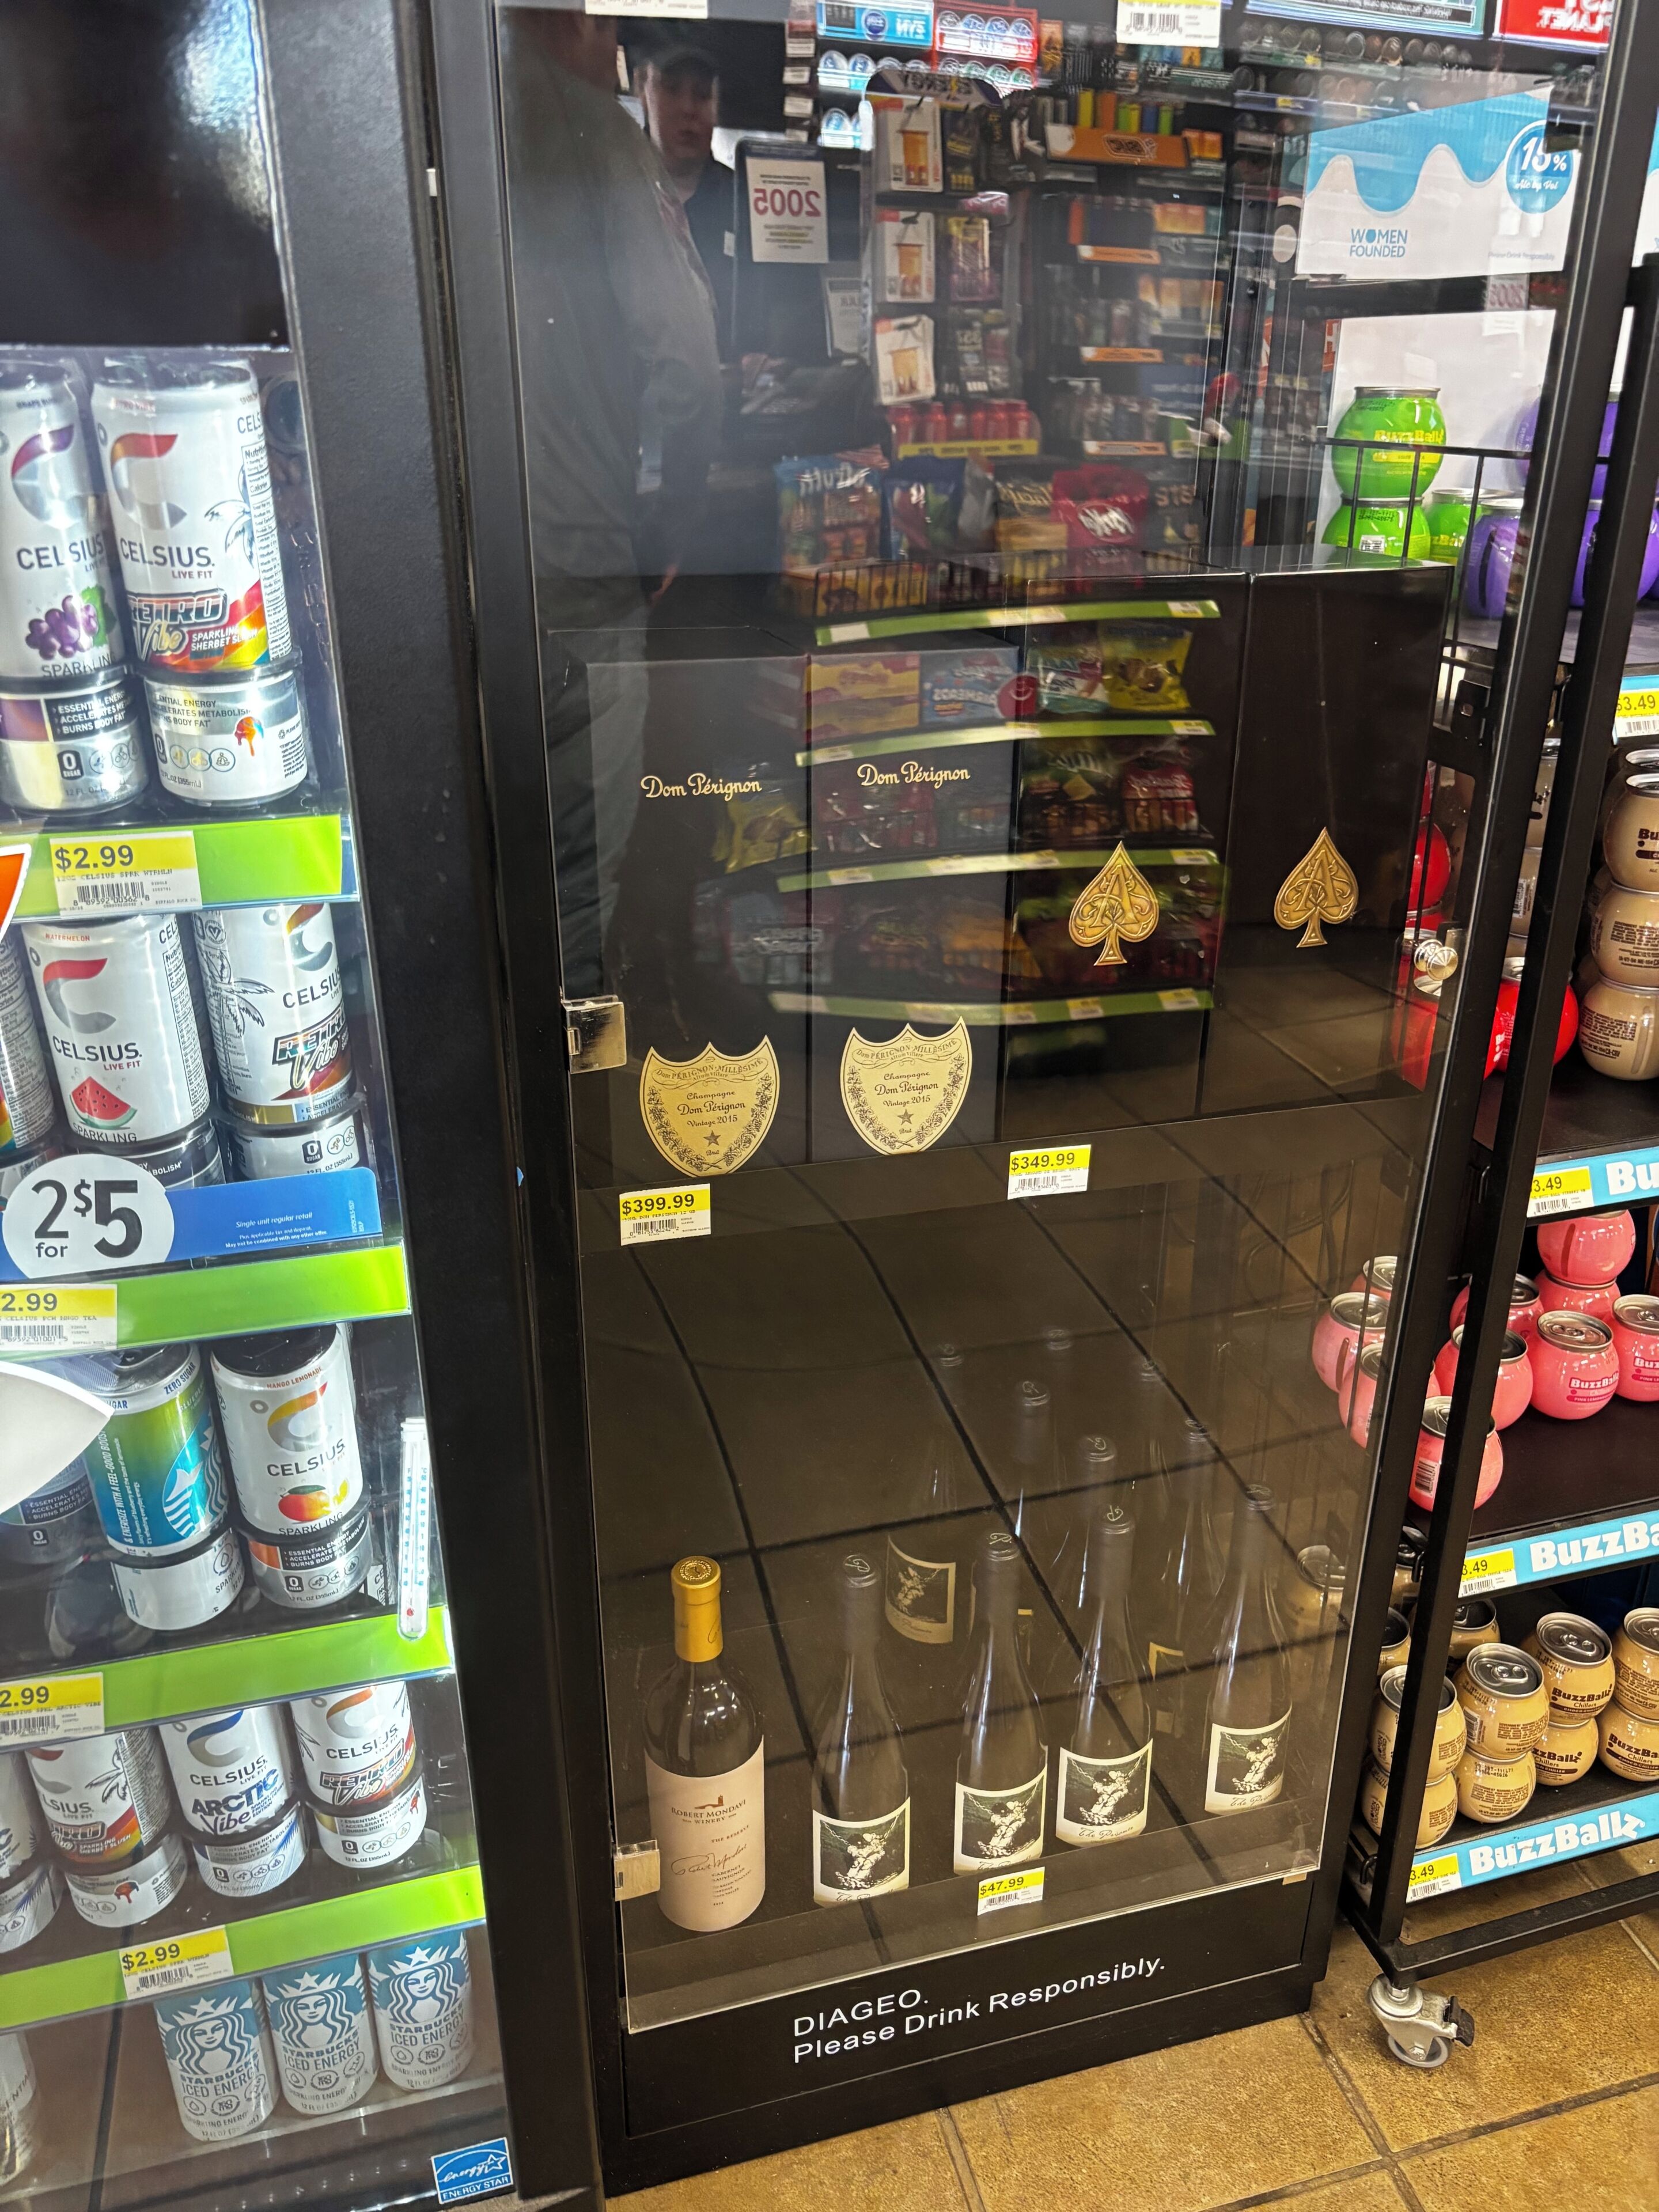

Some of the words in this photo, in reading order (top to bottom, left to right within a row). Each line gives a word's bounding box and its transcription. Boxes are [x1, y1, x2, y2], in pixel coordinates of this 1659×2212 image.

[1349, 245, 1406, 258] FOUNDED
[17, 533, 105, 571] CELSIUS
[119, 536, 215, 568] CELSIUS.
[172, 570, 194, 579] LIVE
[196, 570, 213, 579] FIT
[191, 636, 231, 652] SHERBET
[183, 699, 217, 709] ENERGY
[1616, 694, 1656, 713] $3.49
[62, 722, 94, 734] BURNS
[94, 715, 114, 730] BODY
[173, 716, 193, 726] BODY
[62, 752, 77, 771] 0
[857, 764, 900, 786] Dom
[900, 760, 971, 790] Pérignon
[640, 775, 687, 798] Dom
[687, 772, 763, 802] Pérignon
[54, 844, 134, 873] $2.99
[81, 872, 115, 881] CELSIUS
[45, 932, 90, 942] WATERMELON
[282, 968, 341, 1009] CELSIUS
[52, 1035, 143, 1062] CELSIUS.
[856, 1049, 870, 1059] Dom
[103, 1063, 125, 1071] LIVE
[127, 1060, 141, 1070] FIT
[657, 1069, 671, 1079] Dom
[884, 1071, 930, 1081] Champagne
[686, 1090, 736, 1101] Champagne
[874, 1084, 899, 1096] Dom
[899, 1081, 939, 1094] Pérignon
[677, 1103, 703, 1116] Dom
[703, 1100, 746, 1115] Pérignon
[882, 1100, 910, 1108] Vintage
[911, 1095, 931, 1104] 2015
[687, 1119, 716, 1128] Vintage
[716, 1114, 738, 1124] 2015
[73, 1123, 137, 1143] SPARKLING
[306, 1153, 321, 1161] SUGAR
[308, 1141, 316, 1155] 0
[706, 1149, 719, 1157] Brut
[334, 1152, 353, 1169] (355mL)
[1011, 1152, 1075, 1173] $349.99
[1533, 1175, 1562, 1193] 3.49
[31, 1179, 69, 1239] 2
[622, 1194, 695, 1217] $399.99
[236, 1218, 256, 1229] Single
[257, 1217, 270, 1225] unit
[271, 1214, 294, 1225] regular
[295, 1211, 313, 1221] retail
[225, 1241, 236, 1249] May
[253, 1236, 279, 1245] combined
[279, 1234, 290, 1243] with
[301, 1231, 315, 1239] other
[35, 1241, 69, 1259] for
[1, 1293, 58, 1312] 2.99
[164, 1378, 181, 1395] ZERO
[180, 1361, 196, 1384] SUGAR
[266, 1380, 290, 1389] MANGO
[266, 1437, 346, 1477] CELSIUS
[103, 1451, 119, 1486] FEEL-GOOD
[30, 1493, 69, 1508] ESSENTIAL
[32, 1492, 81, 1514] ACCELERATES
[111, 1491, 125, 1508] WITH
[33, 1510, 59, 1520] BURNS
[59, 1501, 77, 1513] BODY
[116, 1509, 132, 1537] ENERGIZE
[278, 1510, 344, 1536] SPARKLING
[32, 1530, 44, 1541] 0
[288, 1546, 326, 1556] ESSENTIAL
[326, 1530, 350, 1549] ENERGY
[289, 1547, 338, 1562] ACCELERATES
[1529, 1520, 1659, 1573] BuzzBa
[290, 1559, 315, 1567] BURNS
[315, 1554, 334, 1565] BODY
[1461, 1559, 1488, 1576] 3.49
[291, 1576, 299, 1587] 0
[0, 1685, 50, 1708] 2.99
[326, 1724, 399, 1759] CELSIUS
[1608, 1733, 1659, 1759] BuzzBa
[1535, 1756, 1560, 1768] Chillers
[1627, 1753, 1653, 1764] Chillers
[190, 1755, 268, 1786] CELSIUS.
[240, 1775, 255, 1785] LIVE
[192, 1768, 279, 1816] ARCTIC
[671, 1806, 704, 1819] ROBERT
[706, 1798, 747, 1818] MONDAVI
[200, 1811, 251, 1836] Vibe
[344, 1815, 378, 1825] ESSENTIAL
[369, 1822, 385, 1832] BODY
[694, 1816, 726, 1825] WINERY
[110, 1834, 132, 1848] SLUSH
[248, 1834, 273, 1848] ENERGY
[726, 1824, 750, 1840] RESERVE
[79, 1836, 116, 1850] SPARKLING
[346, 1841, 354, 1850] 0
[1468, 1810, 1643, 1877] BuzzBallz
[711, 1865, 741, 1877] CABERNET
[712, 1867, 745, 1882] SAUVIGNON
[1410, 1864, 1434, 1881] 3.49
[980, 1876, 1024, 1896] $47.99
[122, 1943, 180, 1971] $2.99
[389, 2001, 464, 2033] STARBUCKS
[794, 2025, 896, 2064] Please
[904, 2001, 980, 2035] Drink
[988, 1957, 1166, 2013] Responsibly.
[794, 1988, 929, 2037] DIAGEO.
[391, 2031, 418, 2047] ICED
[422, 2008, 464, 2045] ENERGY
[282, 2027, 359, 2059] STARBUCKS
[283, 2054, 310, 2071] ICED
[314, 2037, 359, 2070] ENERGY
[180, 2048, 259, 2085] STARBUCKS
[182, 2082, 210, 2097] ICED
[214, 2059, 259, 2097] ENERGY
[438, 2160, 494, 2183] energy
[442, 2183, 482, 2200] ENERGY
[483, 2176, 509, 2189] STAR
